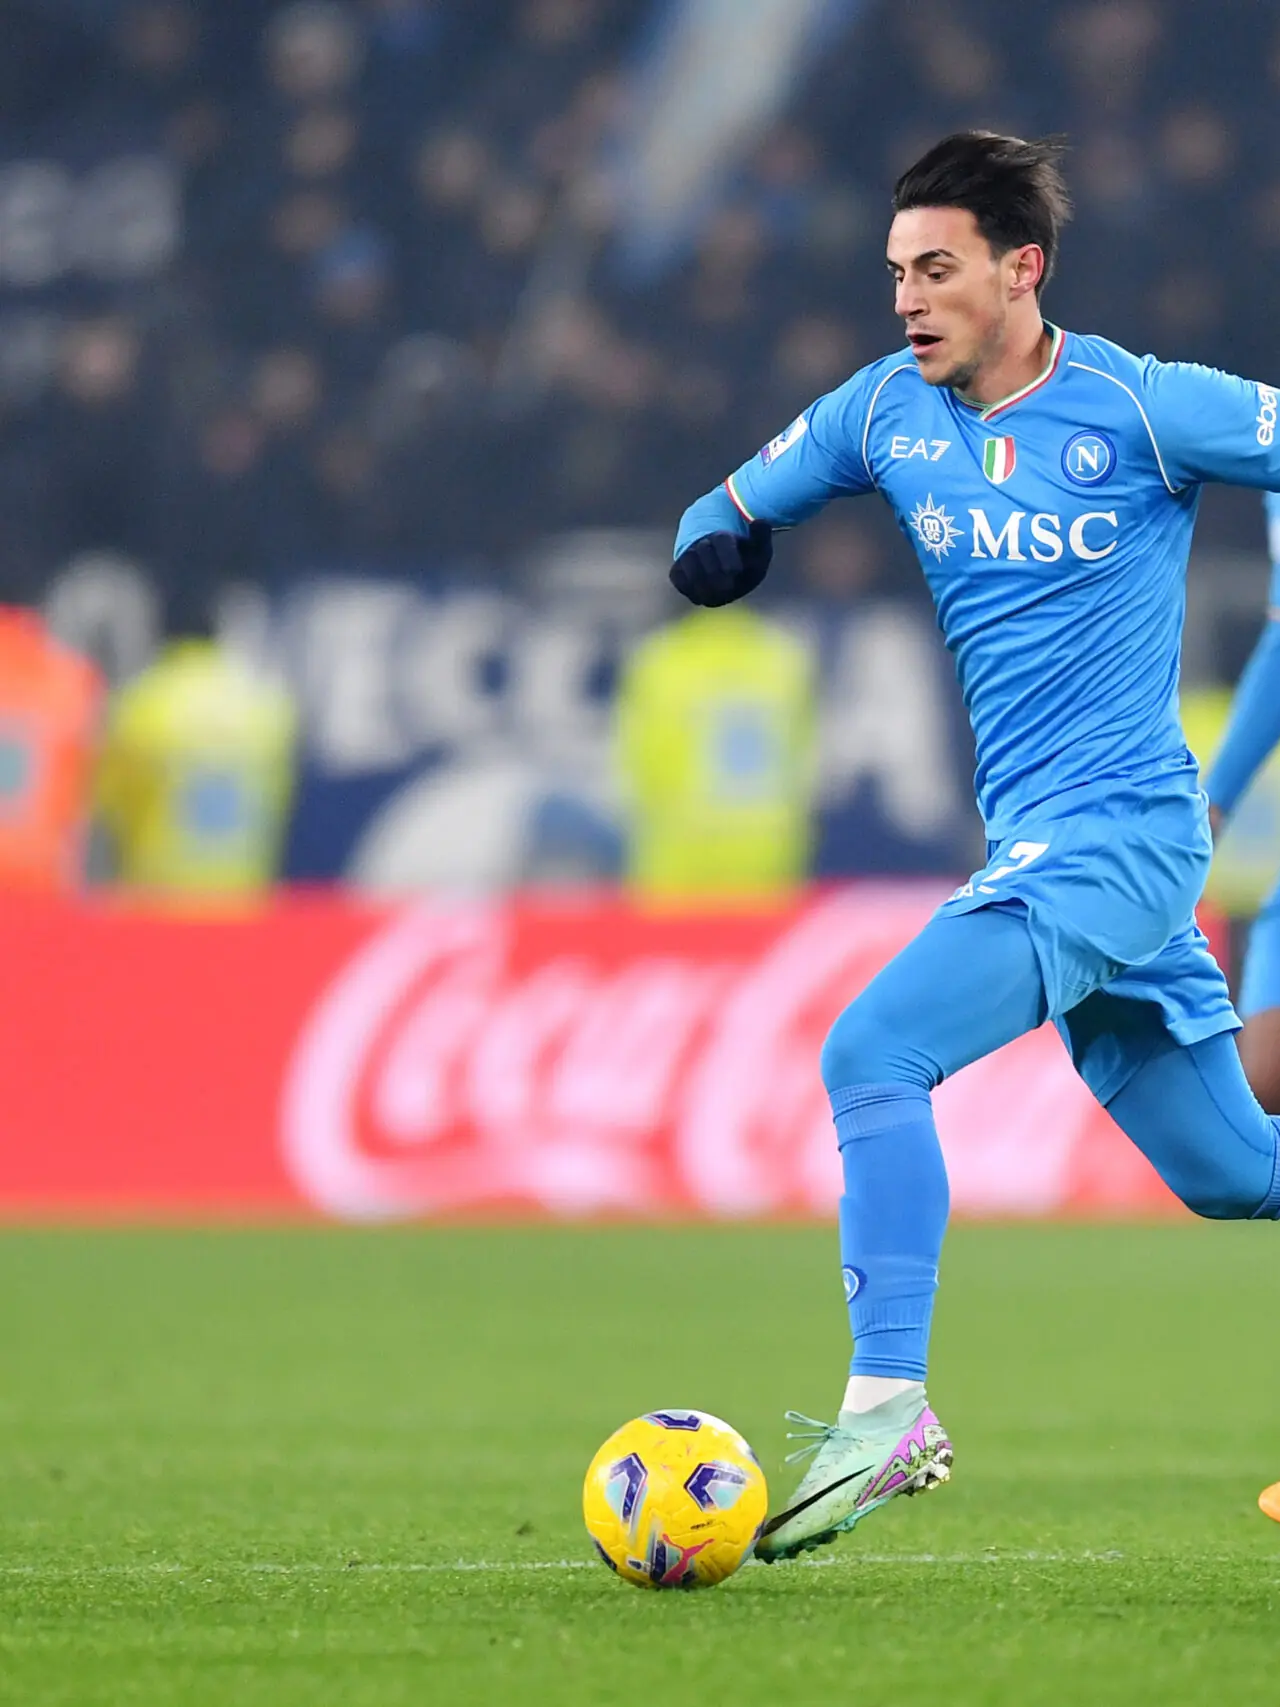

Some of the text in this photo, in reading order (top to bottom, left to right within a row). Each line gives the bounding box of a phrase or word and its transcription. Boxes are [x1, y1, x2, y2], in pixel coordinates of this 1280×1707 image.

[890, 436, 951, 462] EA7
[1075, 445, 1101, 472] N
[968, 508, 1119, 563] MSC
[981, 840, 1050, 883] 7
